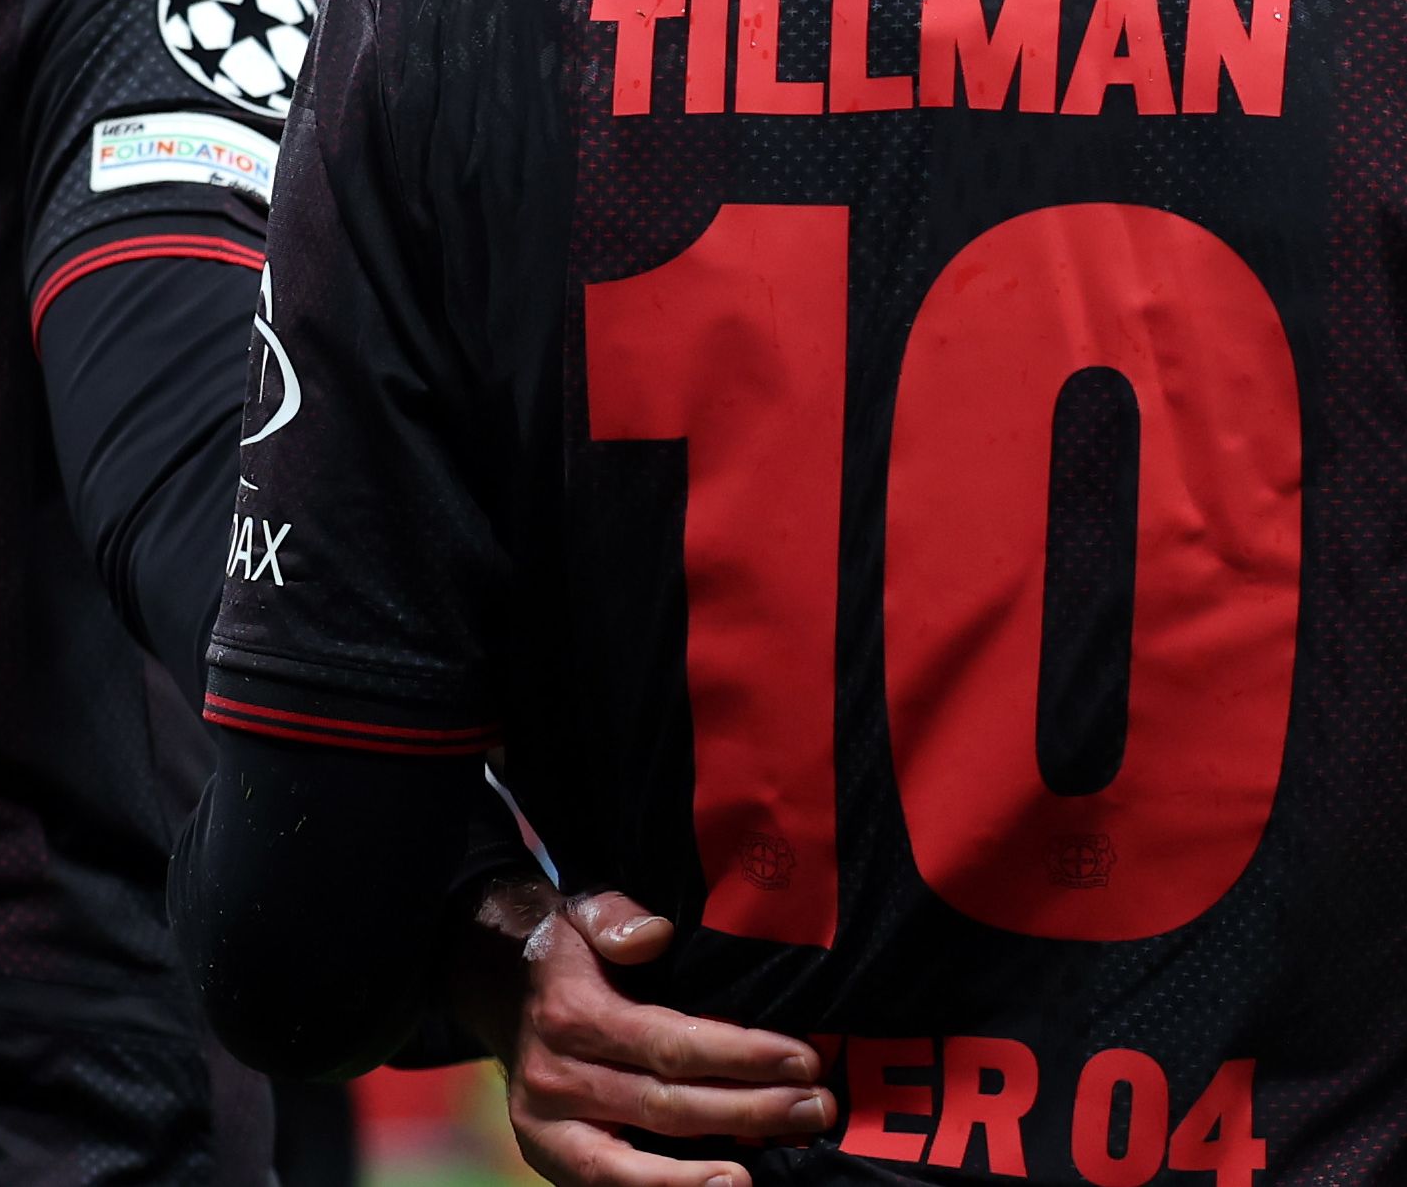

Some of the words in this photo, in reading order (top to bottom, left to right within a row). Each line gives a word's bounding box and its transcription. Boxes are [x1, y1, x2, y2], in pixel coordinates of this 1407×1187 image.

[100, 140, 270, 180] FOUNDATION
[584, 201, 1301, 950] 10
[1071, 1047, 1267, 1187] 04
